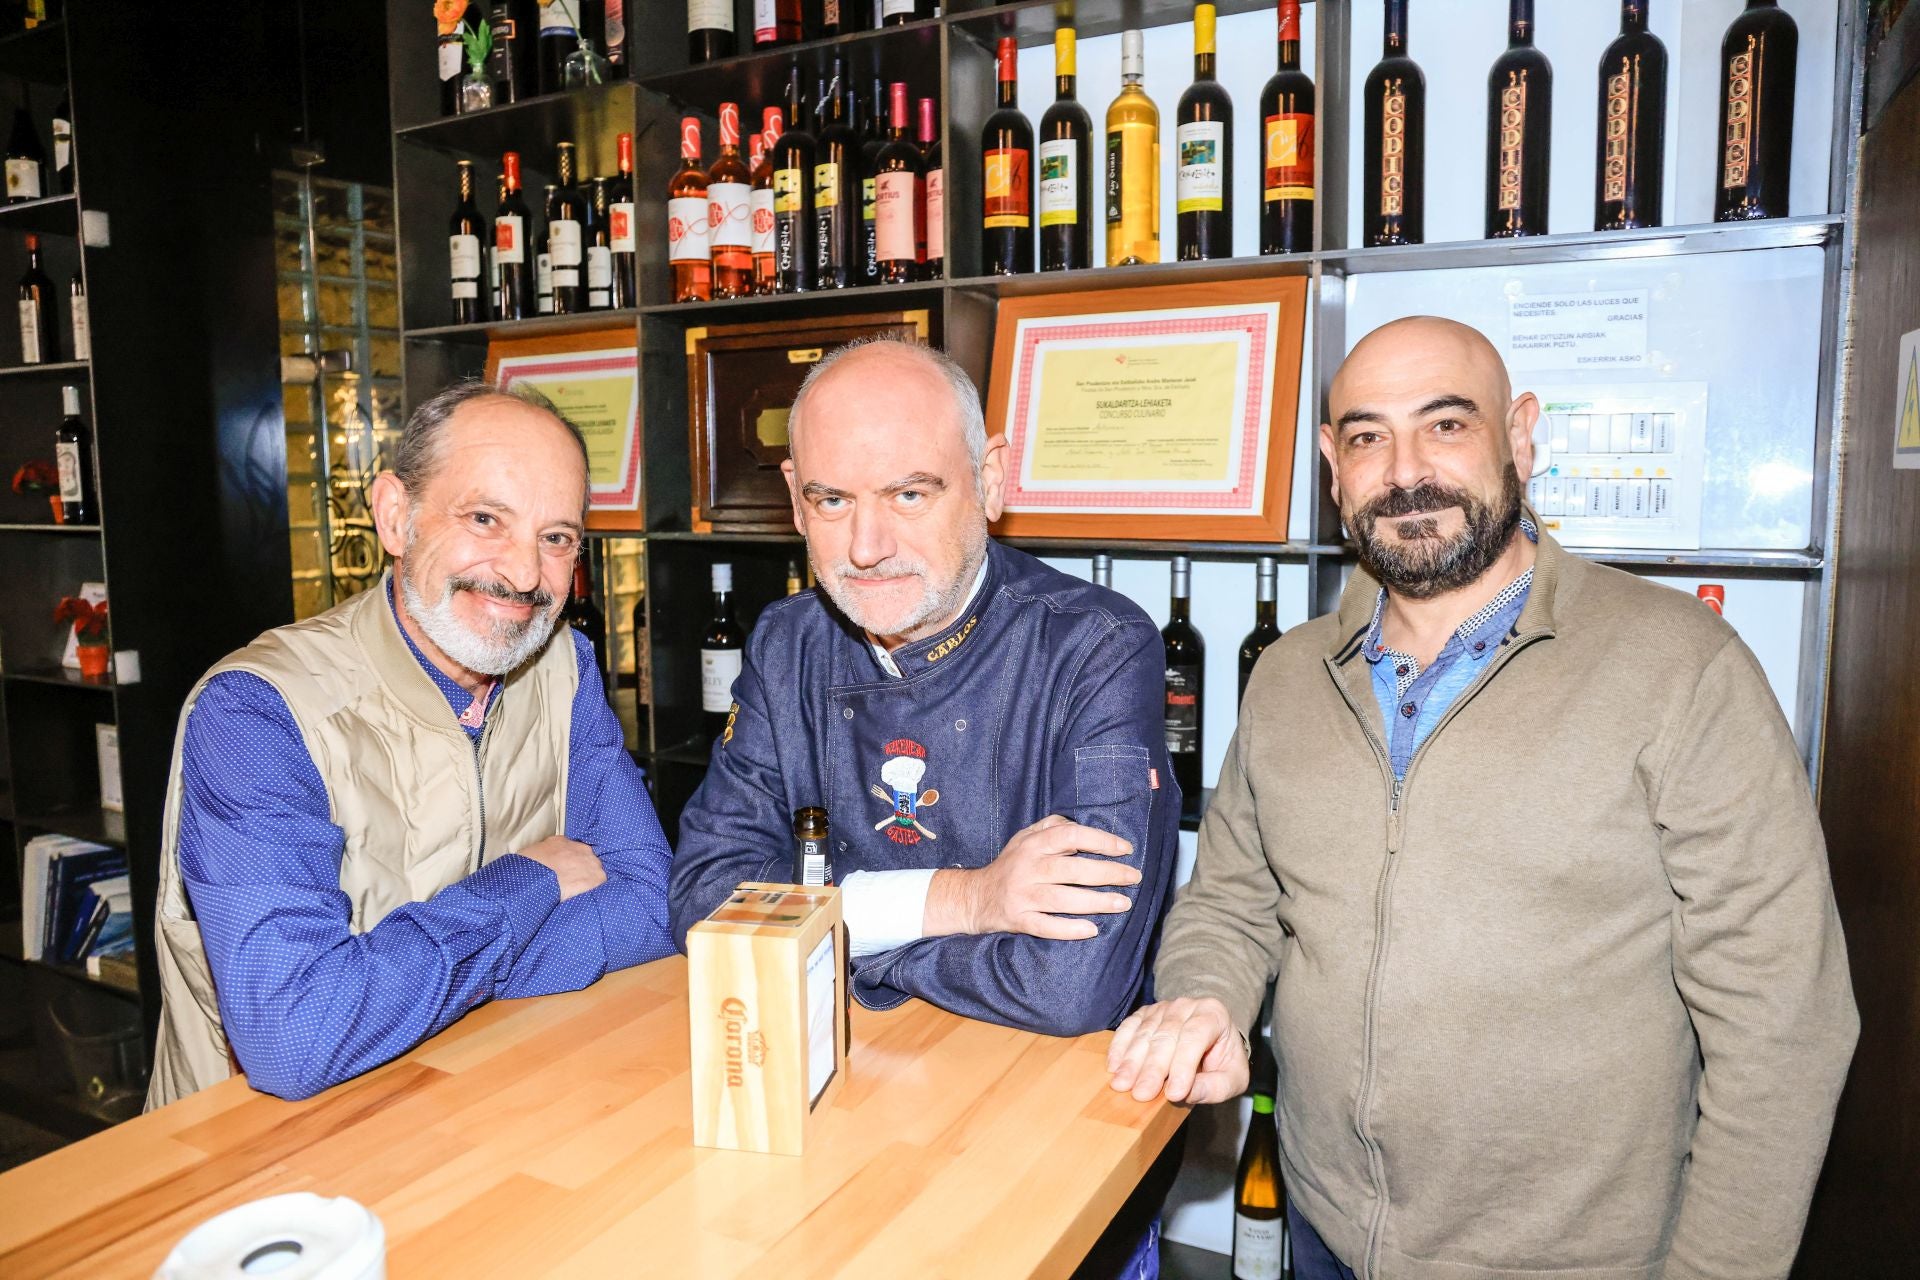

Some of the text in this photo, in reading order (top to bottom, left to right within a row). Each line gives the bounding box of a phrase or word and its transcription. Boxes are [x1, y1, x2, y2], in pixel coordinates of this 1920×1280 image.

[1383, 96, 1404, 214] CODICE
[1501, 88, 1521, 208] CODICE
[1605, 75, 1628, 200] CODICE
[1725, 54, 1750, 187] CODICE
[1513, 301, 1552, 309] ENCIENDE
[1554, 300, 1575, 308] SOLO
[1594, 298, 1620, 306] LUCES
[1622, 297, 1639, 305] QUE
[1607, 313, 1643, 321] GRACIAS
[927, 615, 978, 662] CARLOS
[719, 997, 749, 1088] Corona
